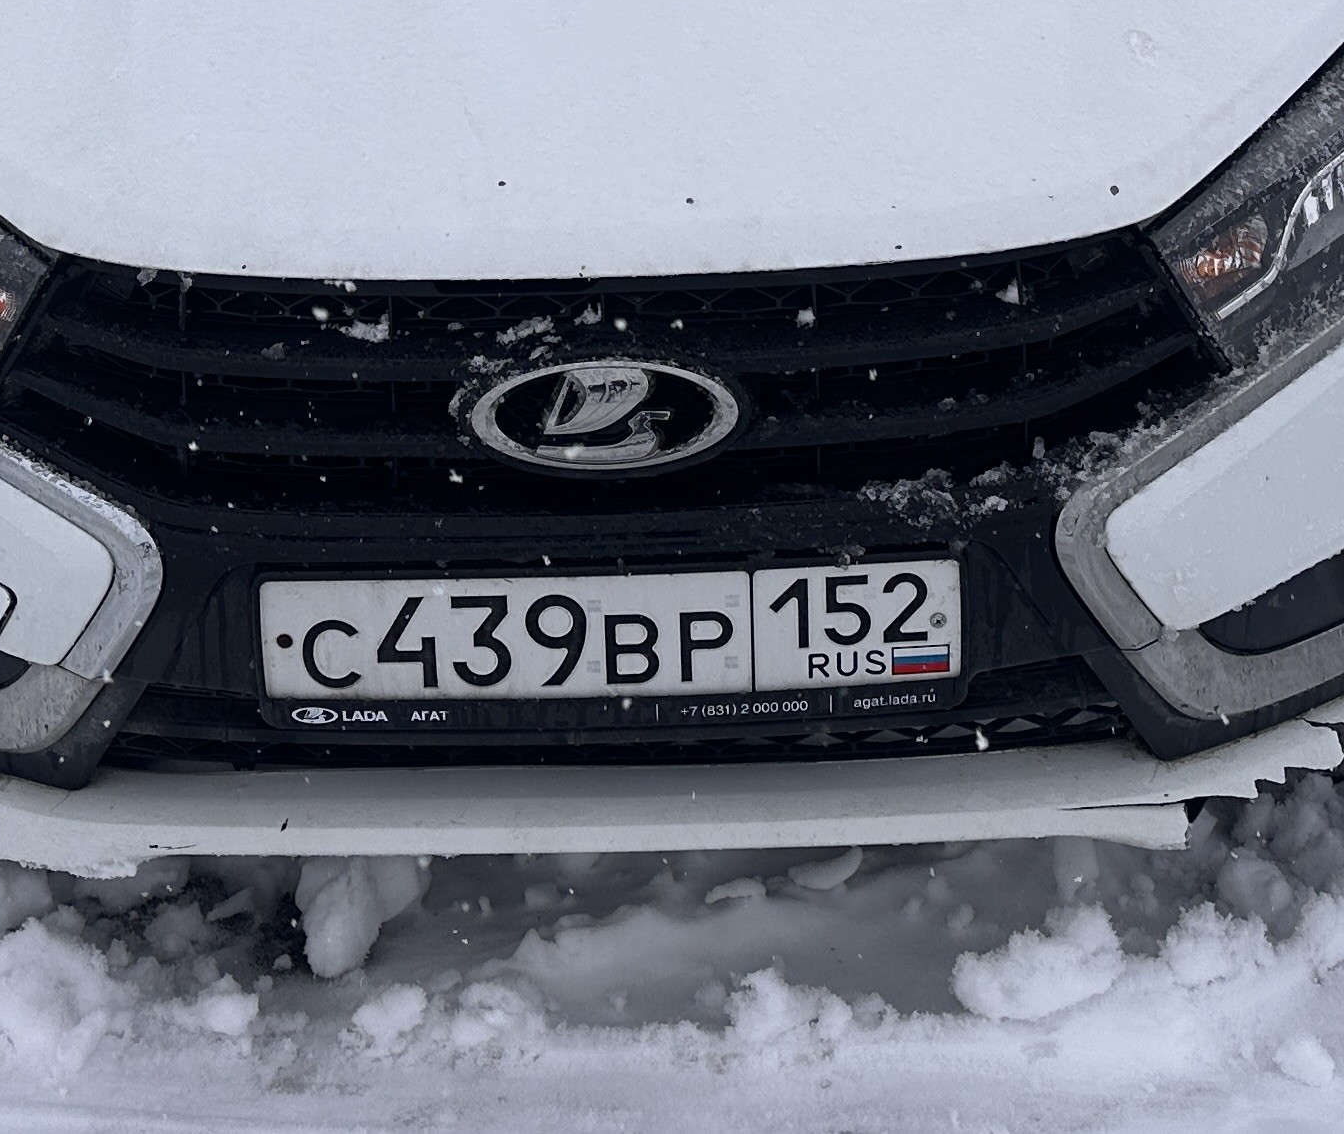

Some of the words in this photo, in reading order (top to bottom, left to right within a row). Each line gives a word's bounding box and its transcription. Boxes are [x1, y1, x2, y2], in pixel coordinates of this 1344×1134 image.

[768, 572, 929, 649] 152
[808, 649, 887, 679] RUS
[853, 692, 937, 710] agat.lada.ru
[342, 710, 389, 722] LADA
[410, 710, 448, 722] АГАТ
[680, 705, 698, 717] +7
[701, 704, 737, 717] (831)
